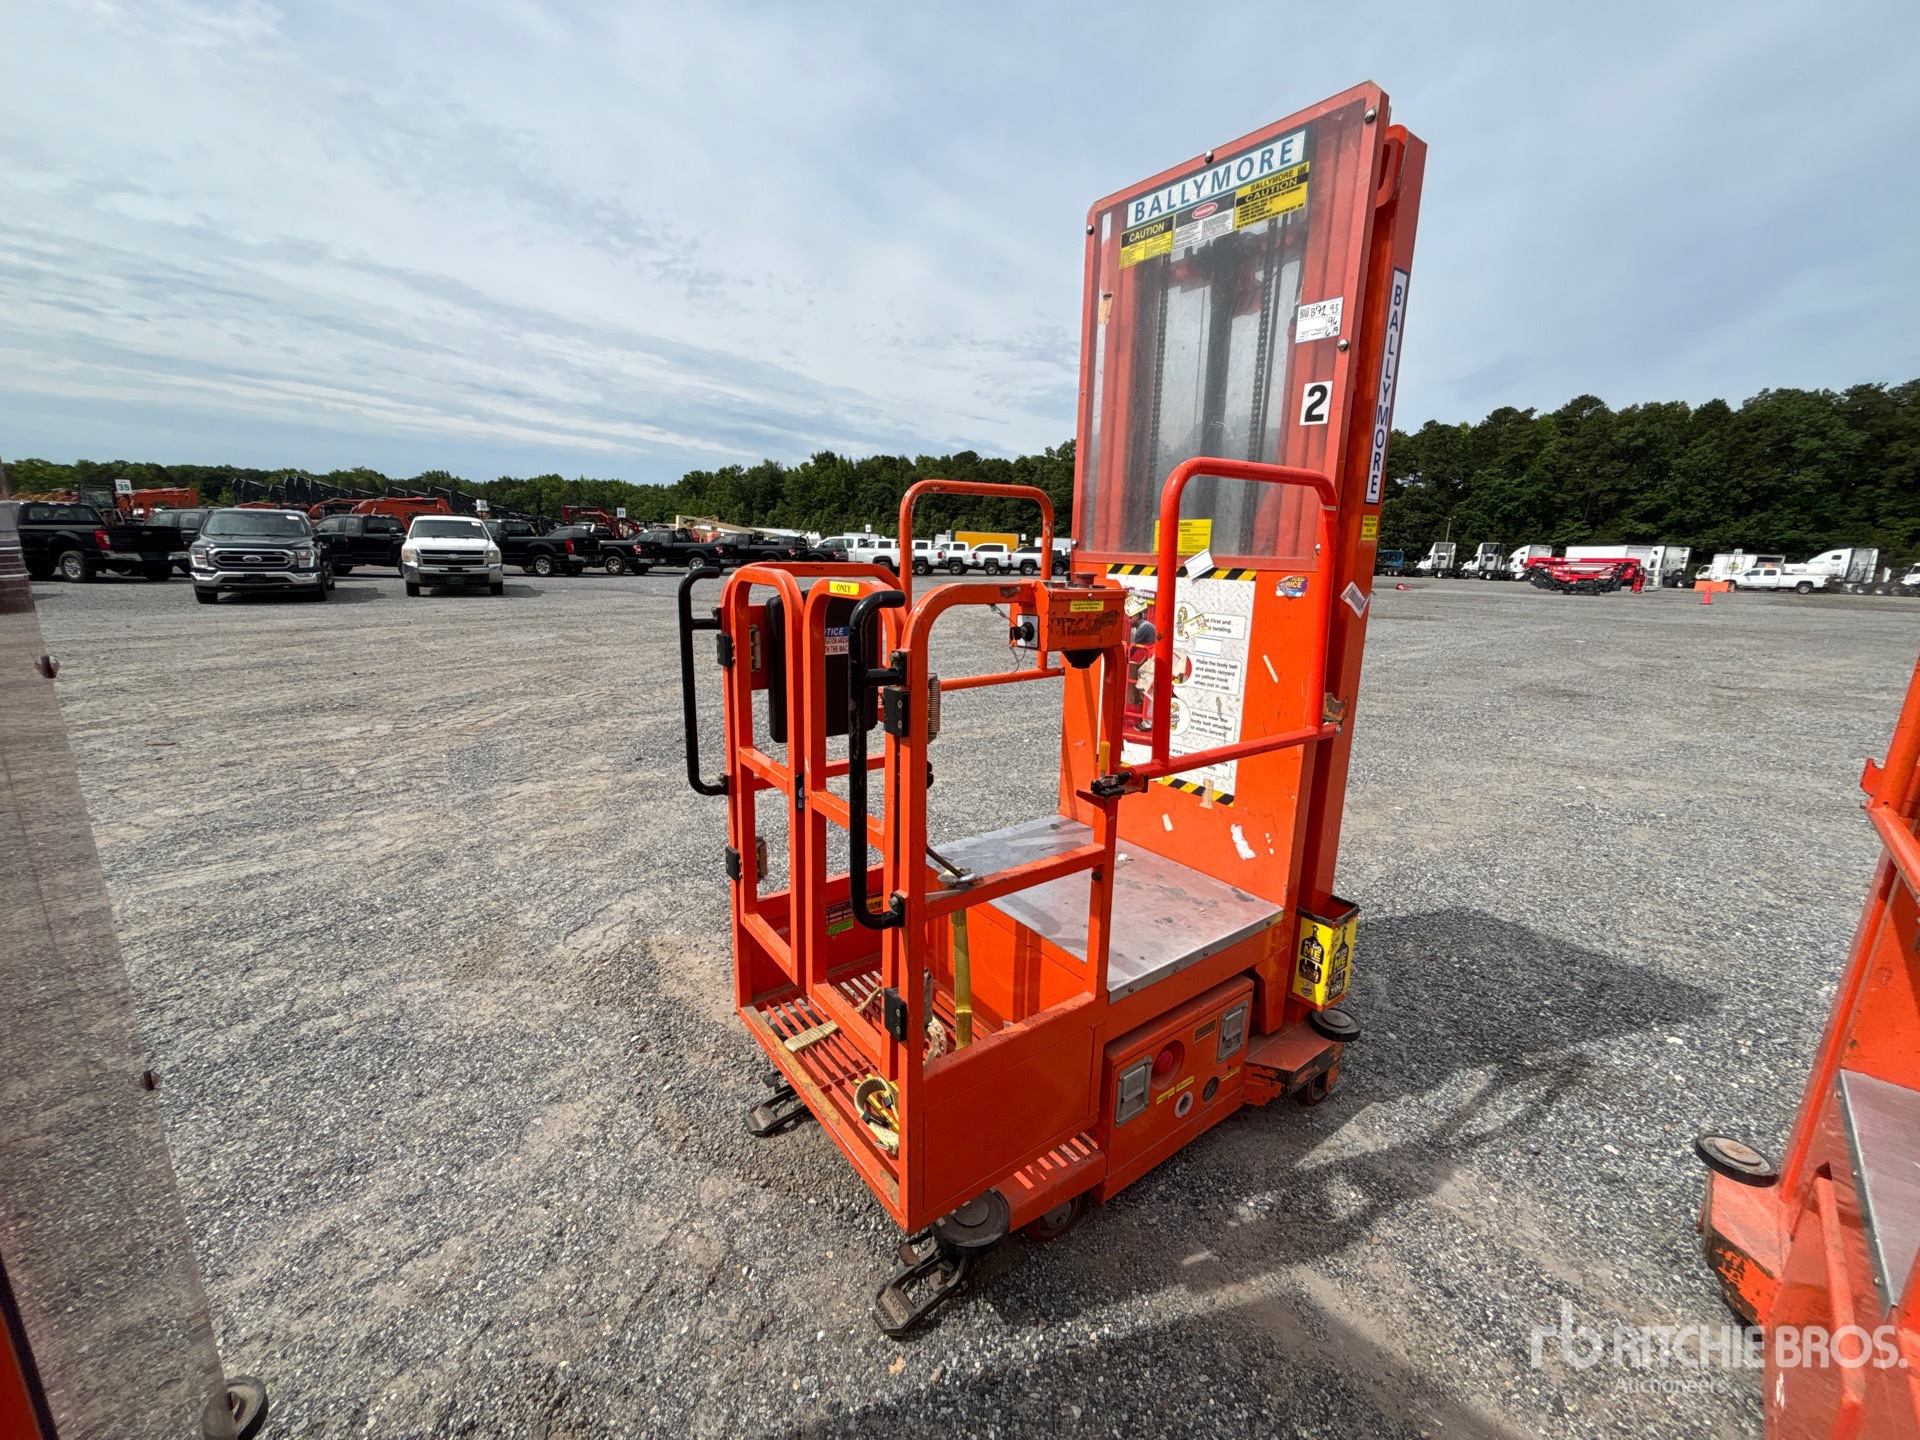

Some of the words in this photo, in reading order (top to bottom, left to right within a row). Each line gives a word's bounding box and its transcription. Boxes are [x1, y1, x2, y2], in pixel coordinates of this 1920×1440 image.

[1135, 138, 1294, 223] BALLYMORE
[1245, 177, 1298, 202] CAUTION
[1250, 170, 1294, 191] BALLYMORE
[1129, 221, 1165, 242] CAUTION
[1370, 284, 1403, 494] BALLYMORE
[1304, 384, 1328, 423] 2
[118, 483, 130, 491] 35
[836, 584, 852, 593] ONLY
[825, 627, 845, 636] TICE
[1191, 711, 1207, 719] Always
[1303, 944, 1322, 959] ME
